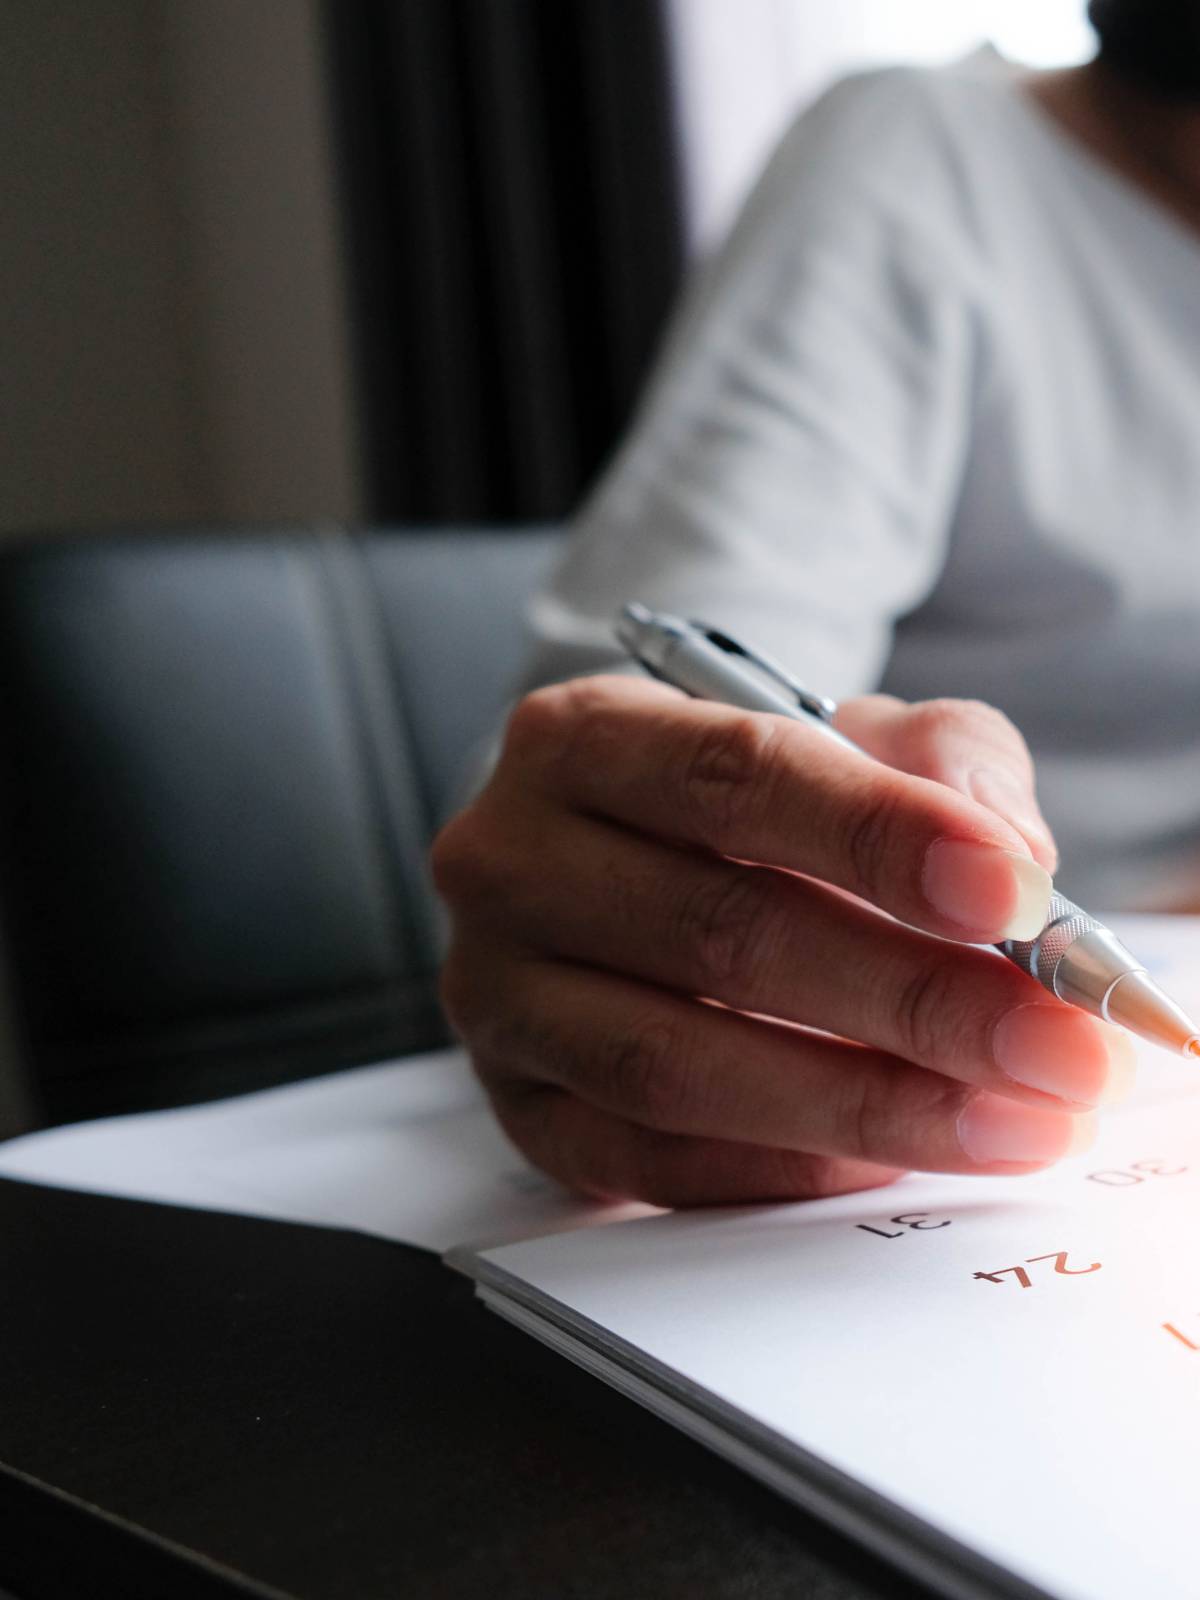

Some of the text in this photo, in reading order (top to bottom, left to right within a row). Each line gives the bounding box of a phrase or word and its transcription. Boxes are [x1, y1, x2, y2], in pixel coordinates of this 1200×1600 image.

[1085, 1157, 1189, 1187] 30
[855, 1211, 951, 1239] 31
[973, 1252, 1101, 1288] 24
